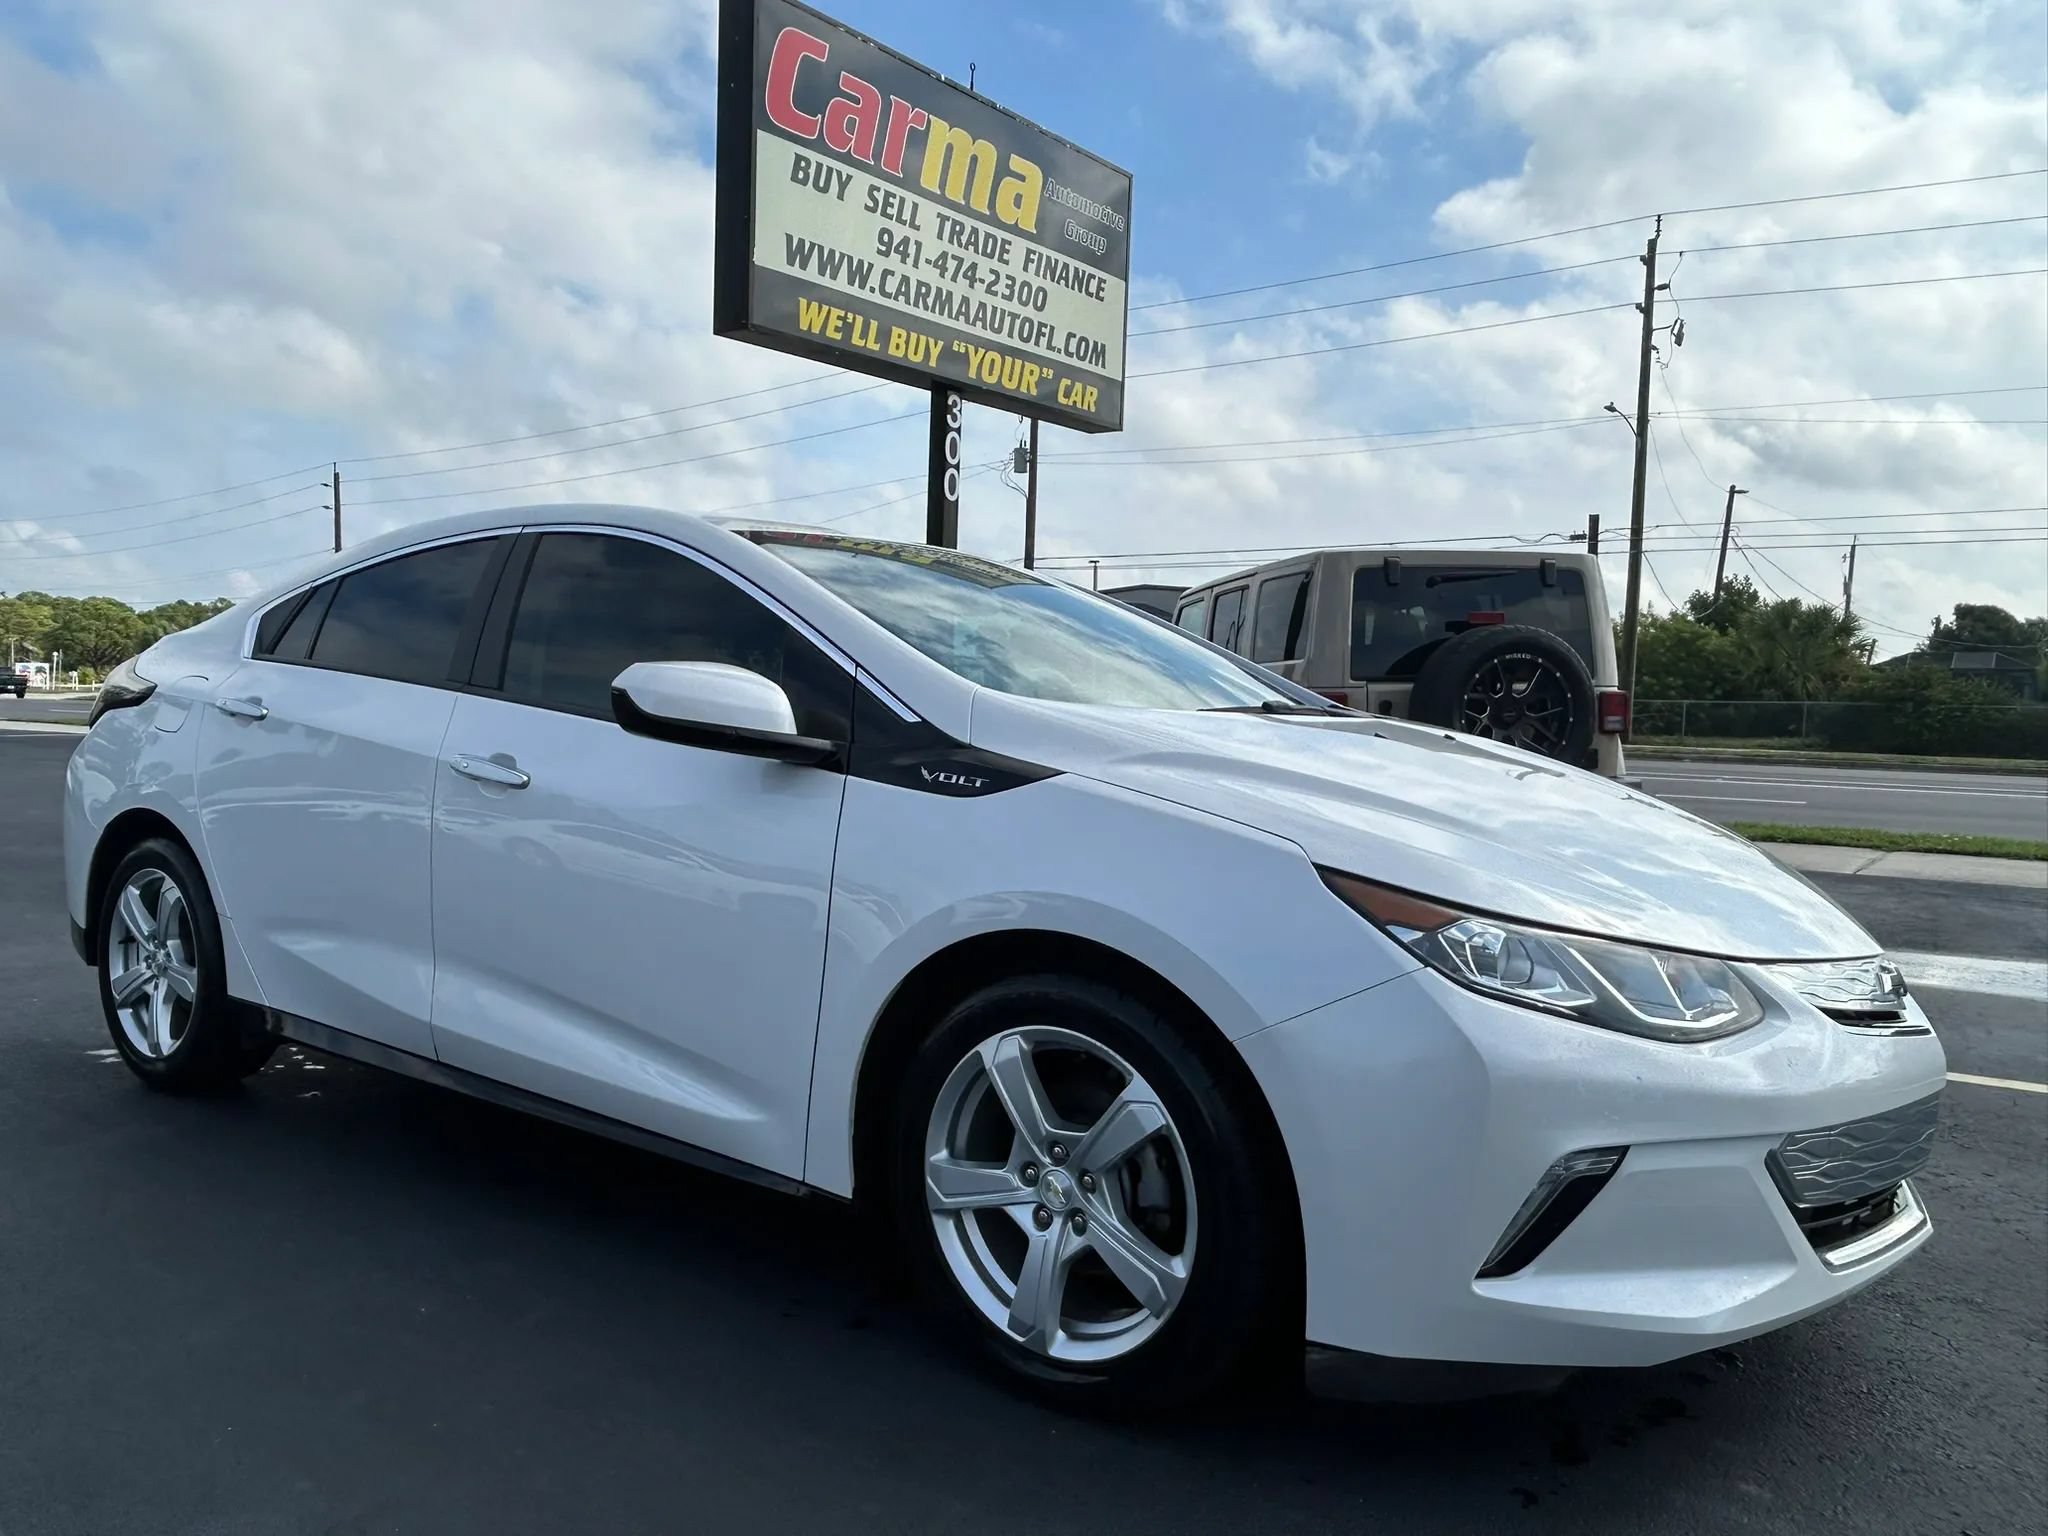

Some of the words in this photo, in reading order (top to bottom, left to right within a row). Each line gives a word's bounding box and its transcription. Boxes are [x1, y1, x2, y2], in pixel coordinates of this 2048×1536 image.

[765, 26, 1043, 232] Carma
[790, 152, 854, 201] BUY
[864, 184, 921, 231] SELL
[936, 211, 1012, 266] TRADE
[1022, 247, 1106, 302] FINANCE
[1044, 177, 1125, 232] Automotive
[1065, 219, 1107, 255] Group
[785, 232, 1106, 369] WWW.CARMAAUTOFL.COM
[876, 231, 1048, 313] 941-474-2300
[798, 297, 880, 352] WE'LL
[888, 327, 944, 368] BUY
[1057, 377, 1098, 412] CAR
[944, 394, 962, 502] 300
[920, 765, 990, 787] VOLT
